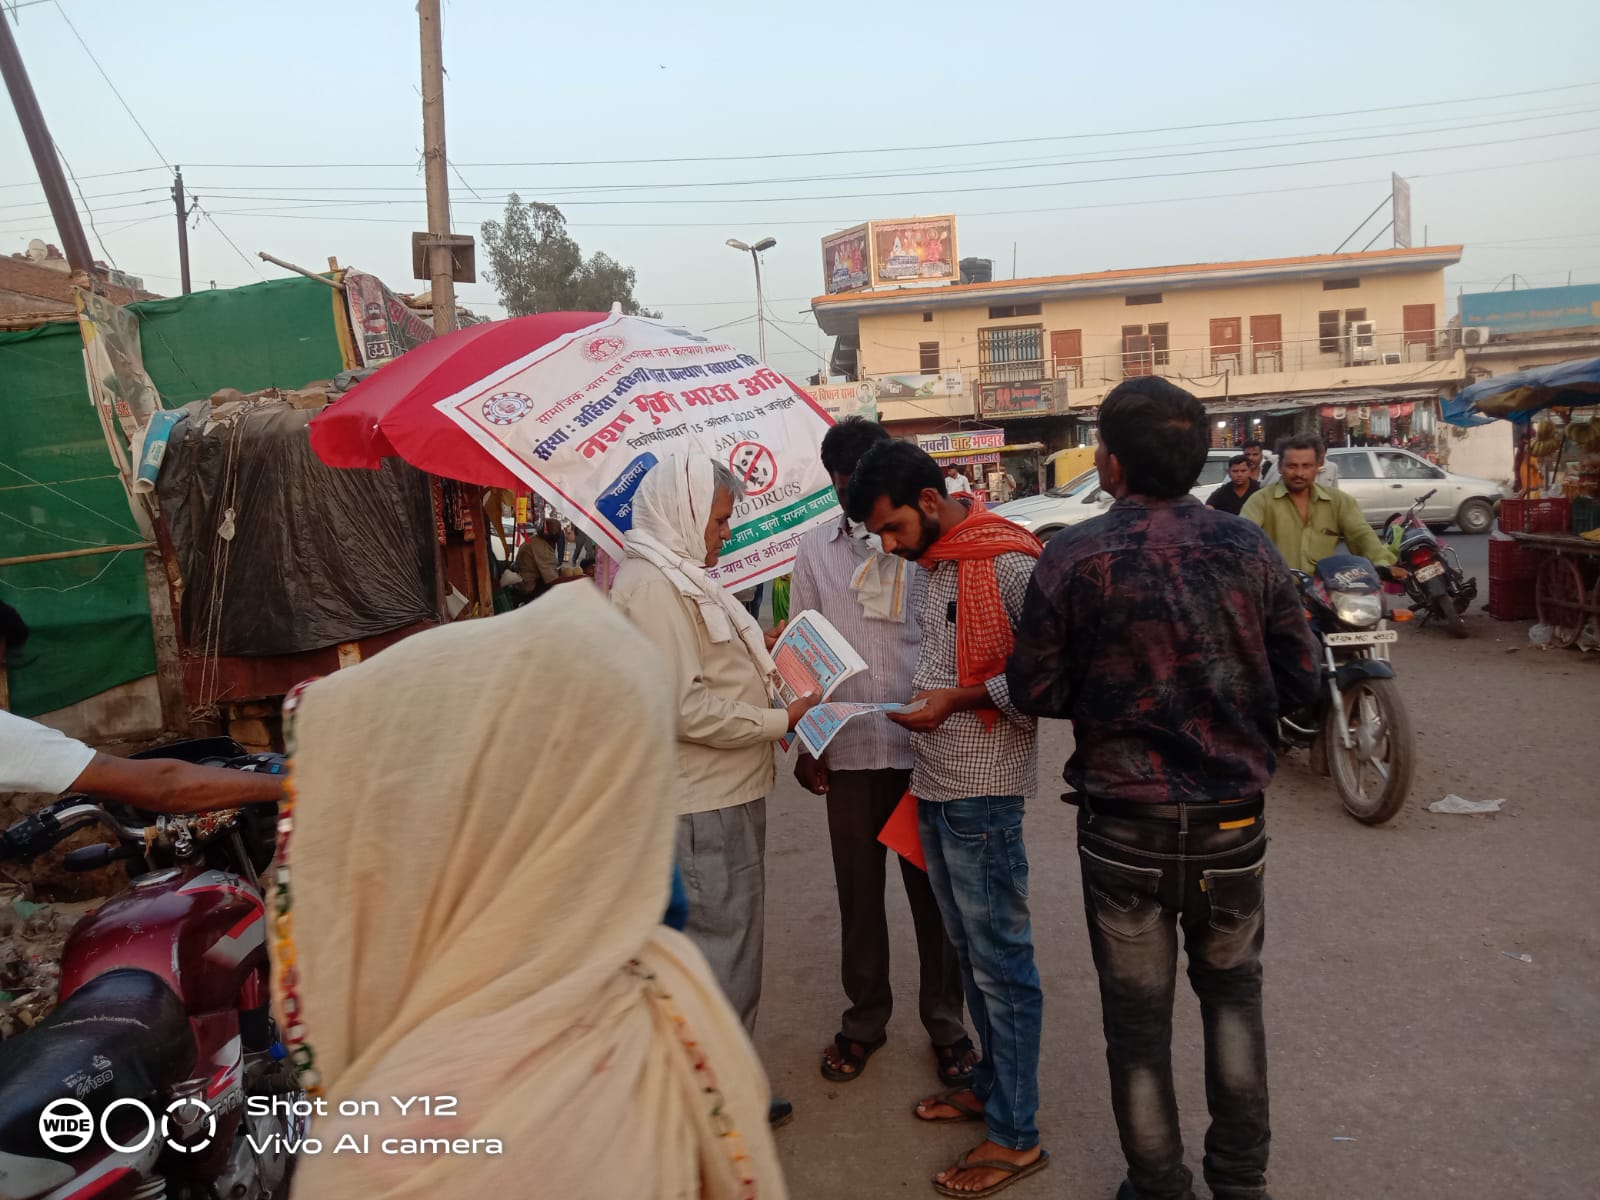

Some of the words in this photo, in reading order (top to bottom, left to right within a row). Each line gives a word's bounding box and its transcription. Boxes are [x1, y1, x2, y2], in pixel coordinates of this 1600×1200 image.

[536, 390, 585, 424] सामाजिक
[585, 375, 608, 392] न्याय
[670, 345, 704, 356] कल्याण
[532, 428, 570, 461] संस्था
[573, 395, 618, 428] अहिंसा
[664, 364, 708, 382] कल्याण
[575, 409, 636, 459] नशा
[679, 382, 740, 407] भारत
[690, 423, 704, 434] 15
[715, 432, 738, 452] SAY
[919, 436, 950, 452] लवली
[951, 434, 972, 450] चाट
[972, 433, 1005, 448] भण्डार
[611, 461, 646, 496] ग्वालियर
[734, 500, 751, 519] TO
[752, 480, 801, 512] DRUGS
[758, 514, 781, 531] चलो
[781, 504, 809, 523] सफल
[807, 488, 838, 509] बनाएं
[720, 557, 744, 576] न्याय
[744, 546, 761, 568] एवं
